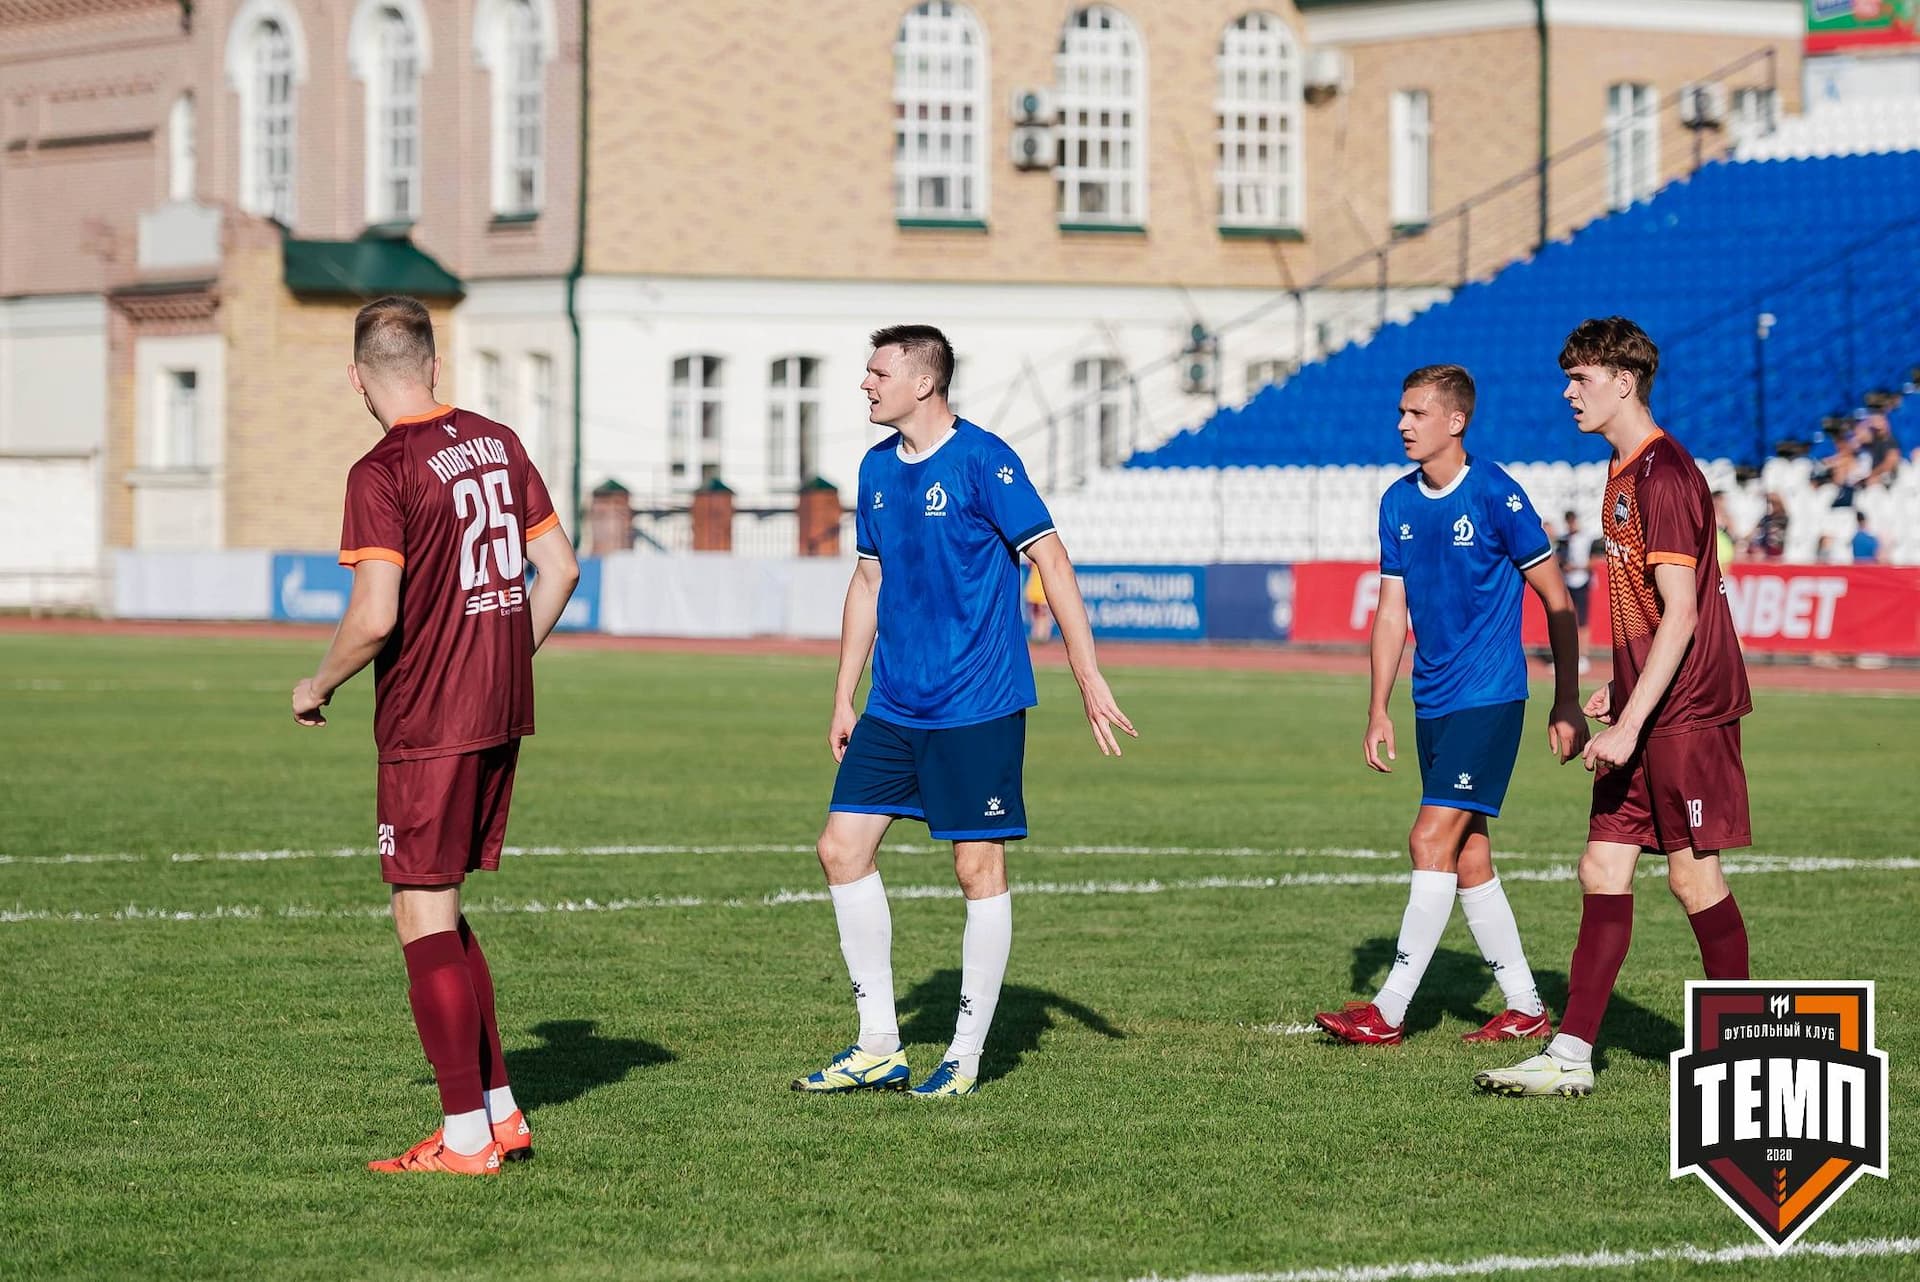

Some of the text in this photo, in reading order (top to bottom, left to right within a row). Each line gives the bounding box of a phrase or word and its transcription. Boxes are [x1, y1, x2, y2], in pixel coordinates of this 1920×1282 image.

[427, 437, 509, 484] НОВИЧКОВ
[453, 469, 522, 591] 25
[1724, 575, 1848, 639] NBET
[1687, 799, 1702, 827] 18
[379, 823, 395, 856] 25
